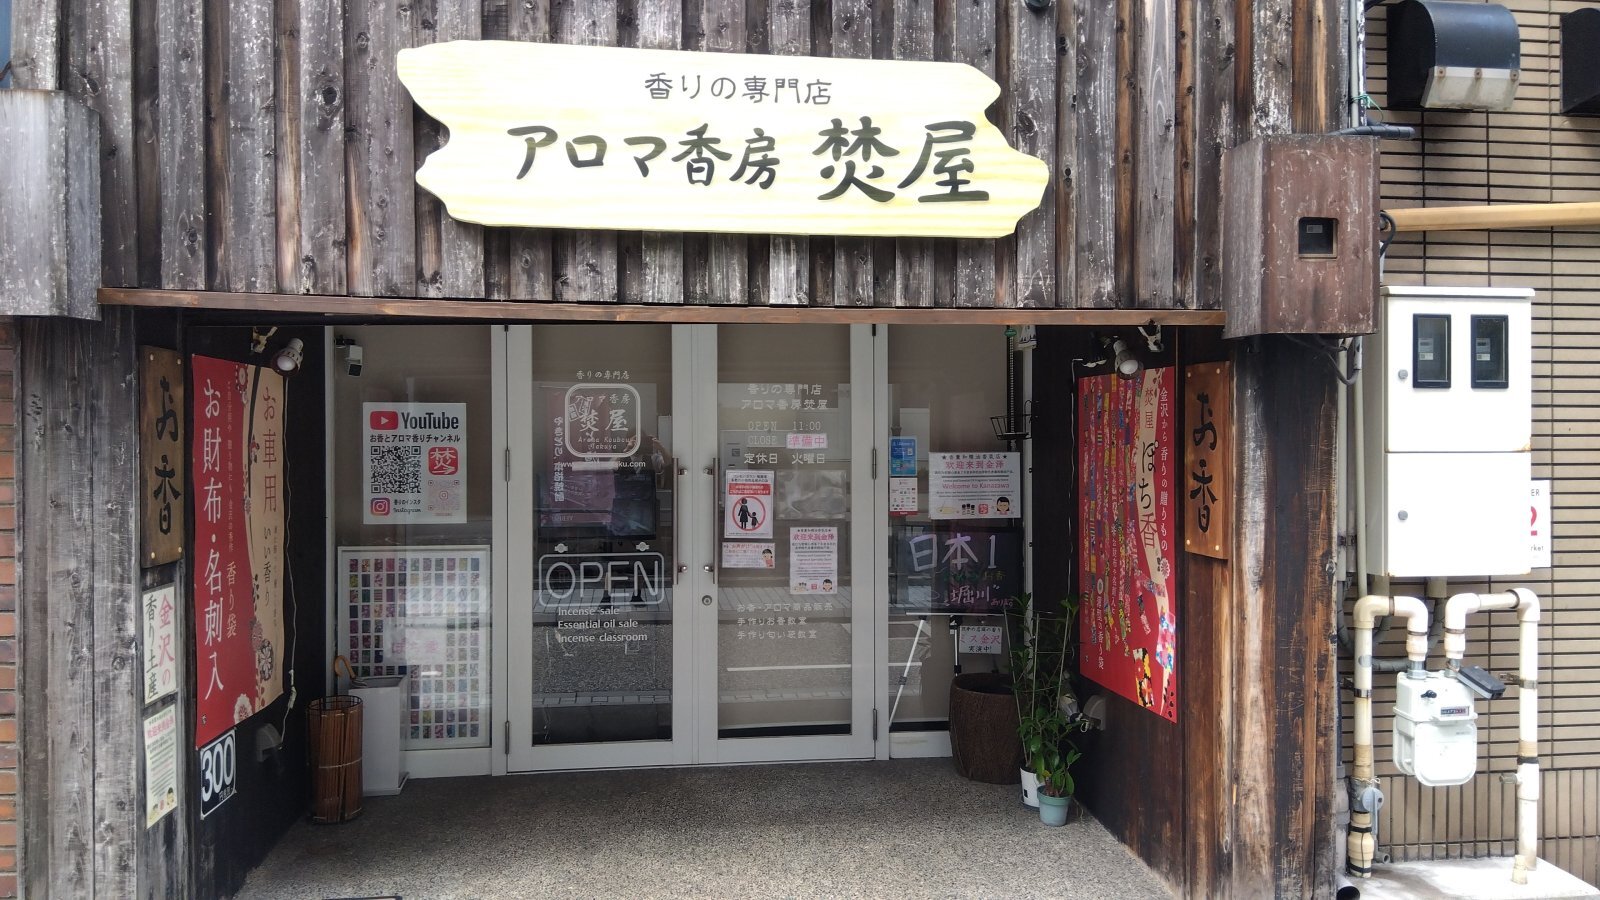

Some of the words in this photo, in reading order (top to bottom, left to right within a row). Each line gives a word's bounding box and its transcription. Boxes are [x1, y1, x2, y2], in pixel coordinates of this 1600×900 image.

[644, 72, 832, 106] 香りの専門店
[508, 122, 780, 190] アロマ香房
[813, 115, 989, 203] 焚屋
[576, 370, 630, 380] 香りの専門店
[747, 383, 822, 395] 香りの専門店
[401, 411, 459, 430] YouTube
[748, 421, 777, 431] OPEN
[793, 421, 821, 431] 11:00
[748, 436, 777, 445] CLOSE
[789, 435, 825, 447] 準備中
[153, 376, 182, 535] お香
[743, 453, 778, 464] 定休日
[791, 453, 826, 464] 火曜日
[1189, 391, 1219, 533] お香
[545, 560, 659, 599] OPEN
[558, 607, 596, 616] Incense
[600, 606, 620, 615] sale
[558, 620, 601, 630] Essential
[603, 619, 616, 629] oil
[618, 618, 639, 628] sale
[158, 594, 175, 687] 金沢の
[557, 635, 596, 643] Incense
[599, 633, 648, 642] classroom
[201, 736, 234, 802] 300
